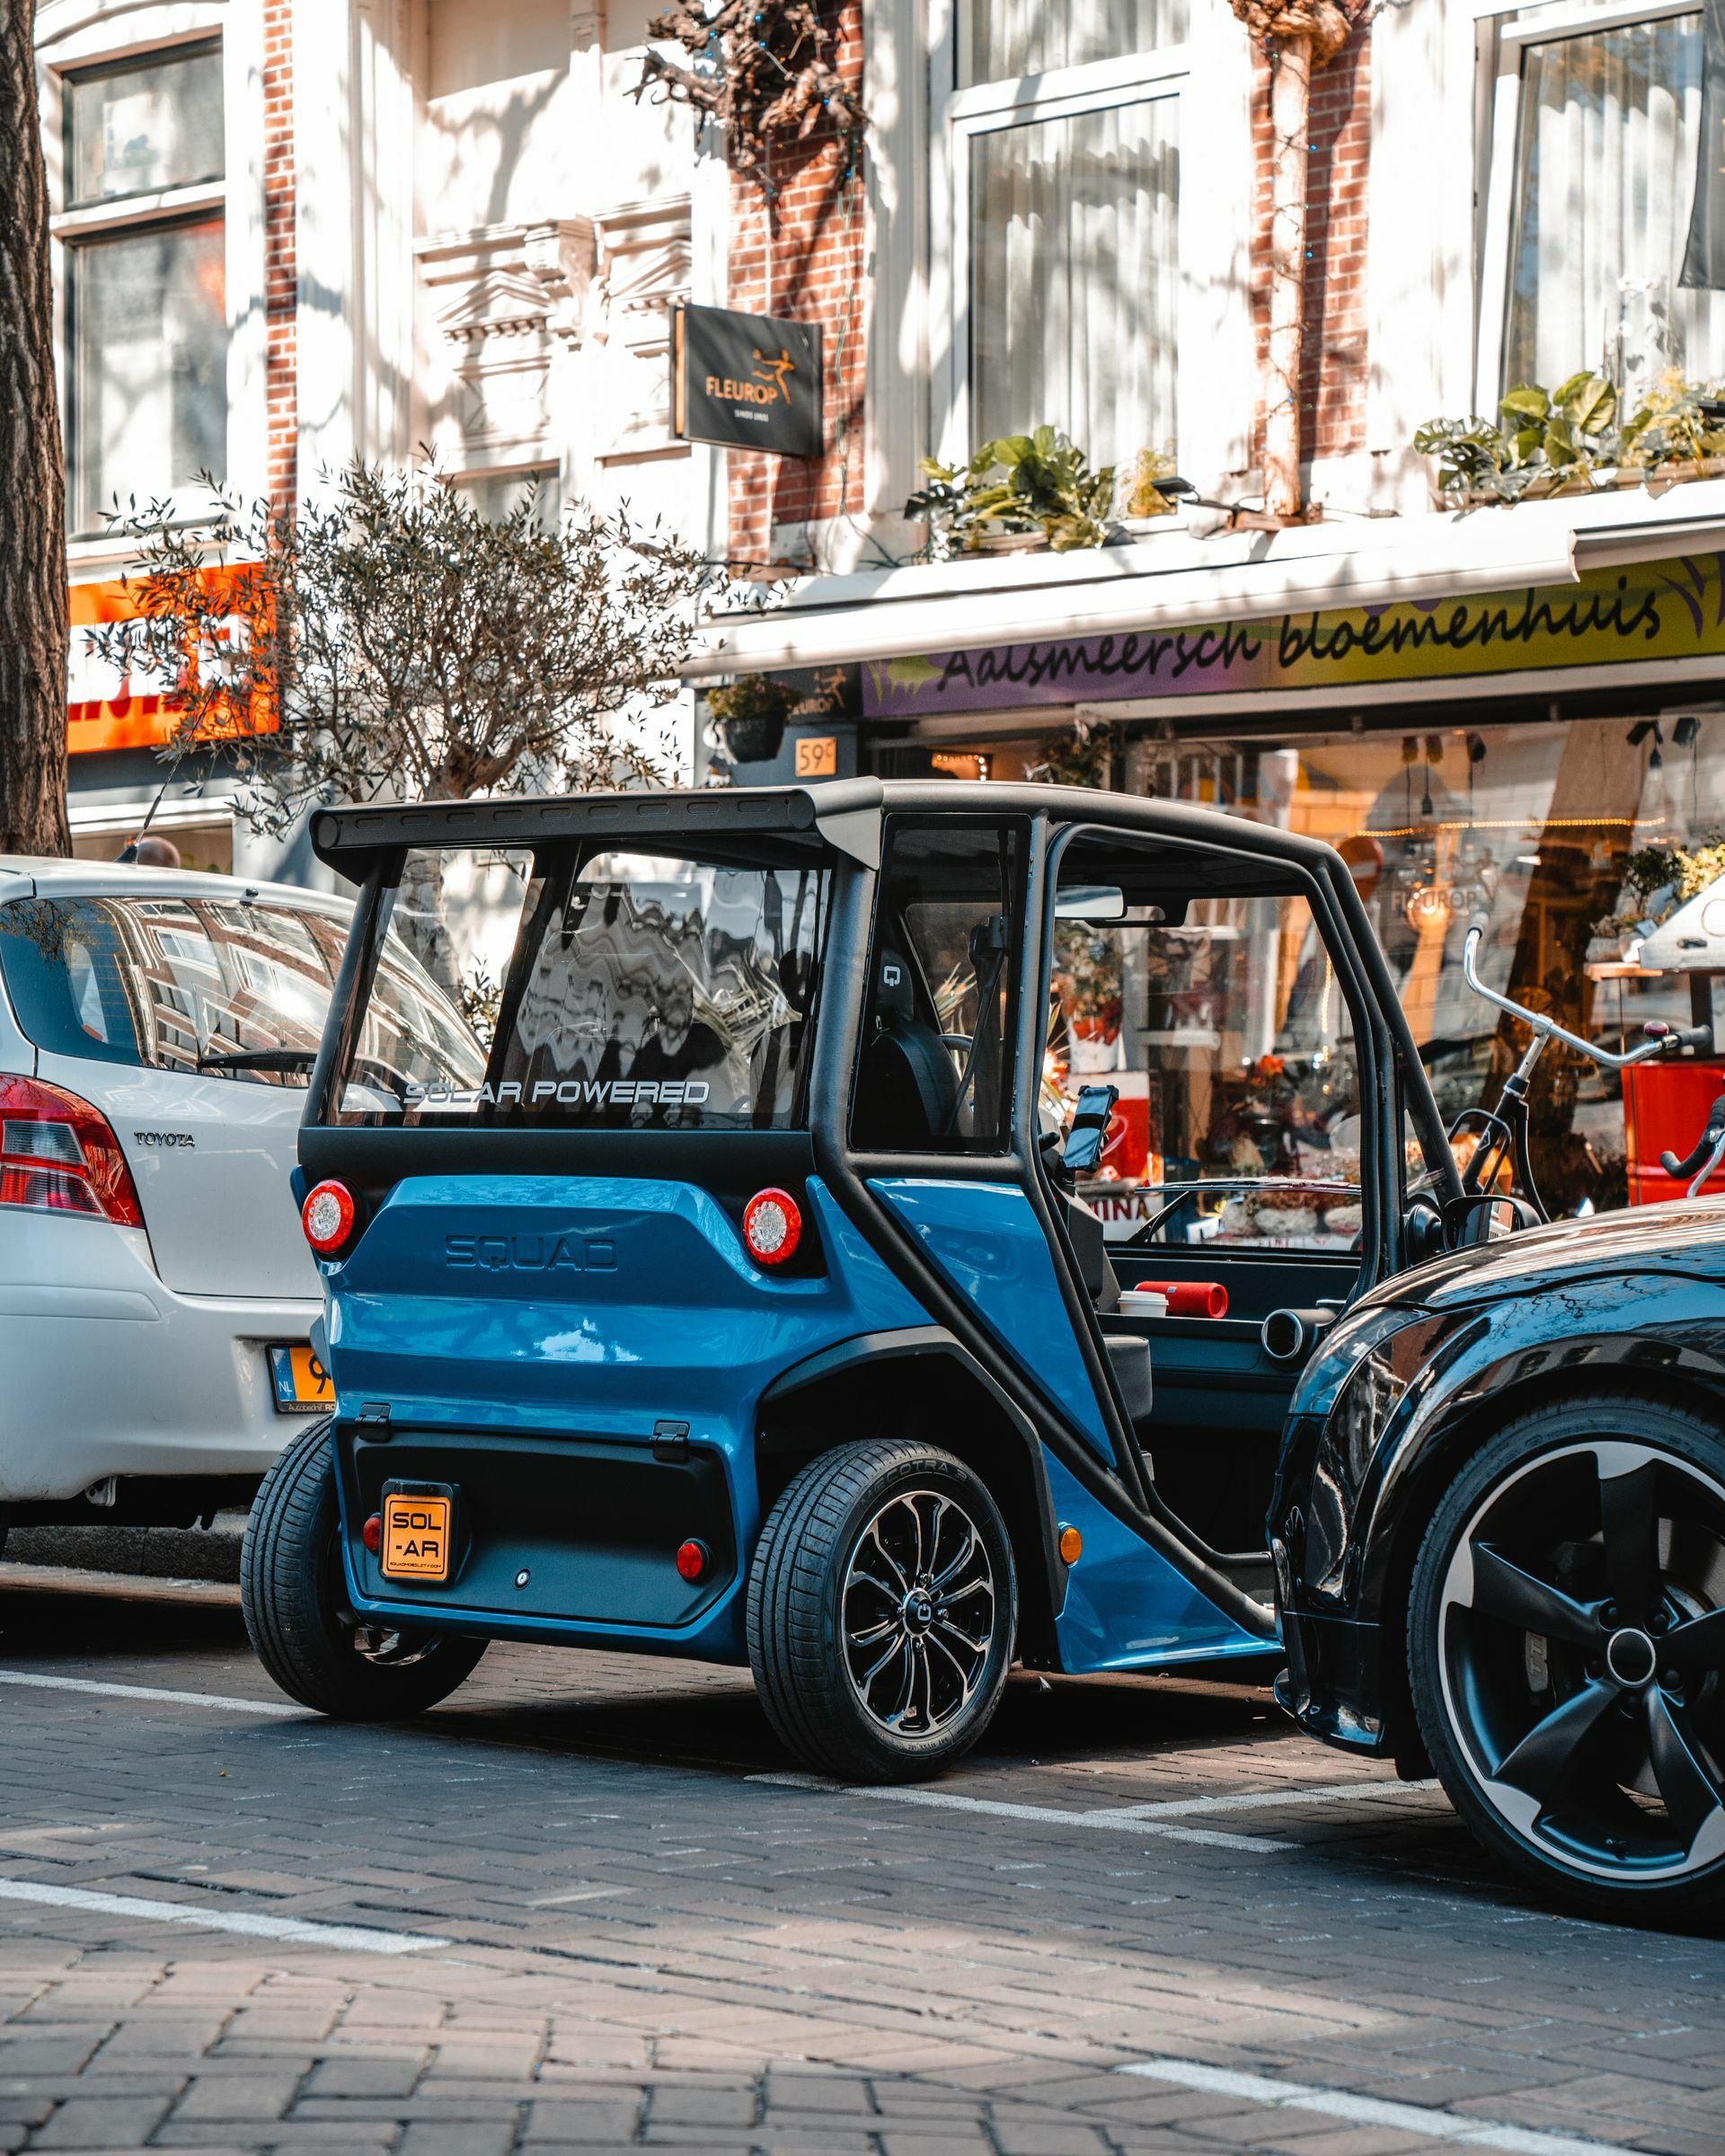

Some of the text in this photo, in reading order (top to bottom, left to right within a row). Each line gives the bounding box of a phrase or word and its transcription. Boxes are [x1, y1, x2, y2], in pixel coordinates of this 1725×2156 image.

[705, 376, 779, 404] FLEUROP
[1278, 576, 1660, 668] bloemenhuis
[403, 1081, 711, 1104] SOLAR POWERED
[135, 1132, 195, 1147] TOYOTA
[445, 1234, 619, 1272] SQUAD
[278, 1380, 294, 1393] NL
[393, 1512, 442, 1531] SOL
[395, 1540, 439, 1558] -AR
